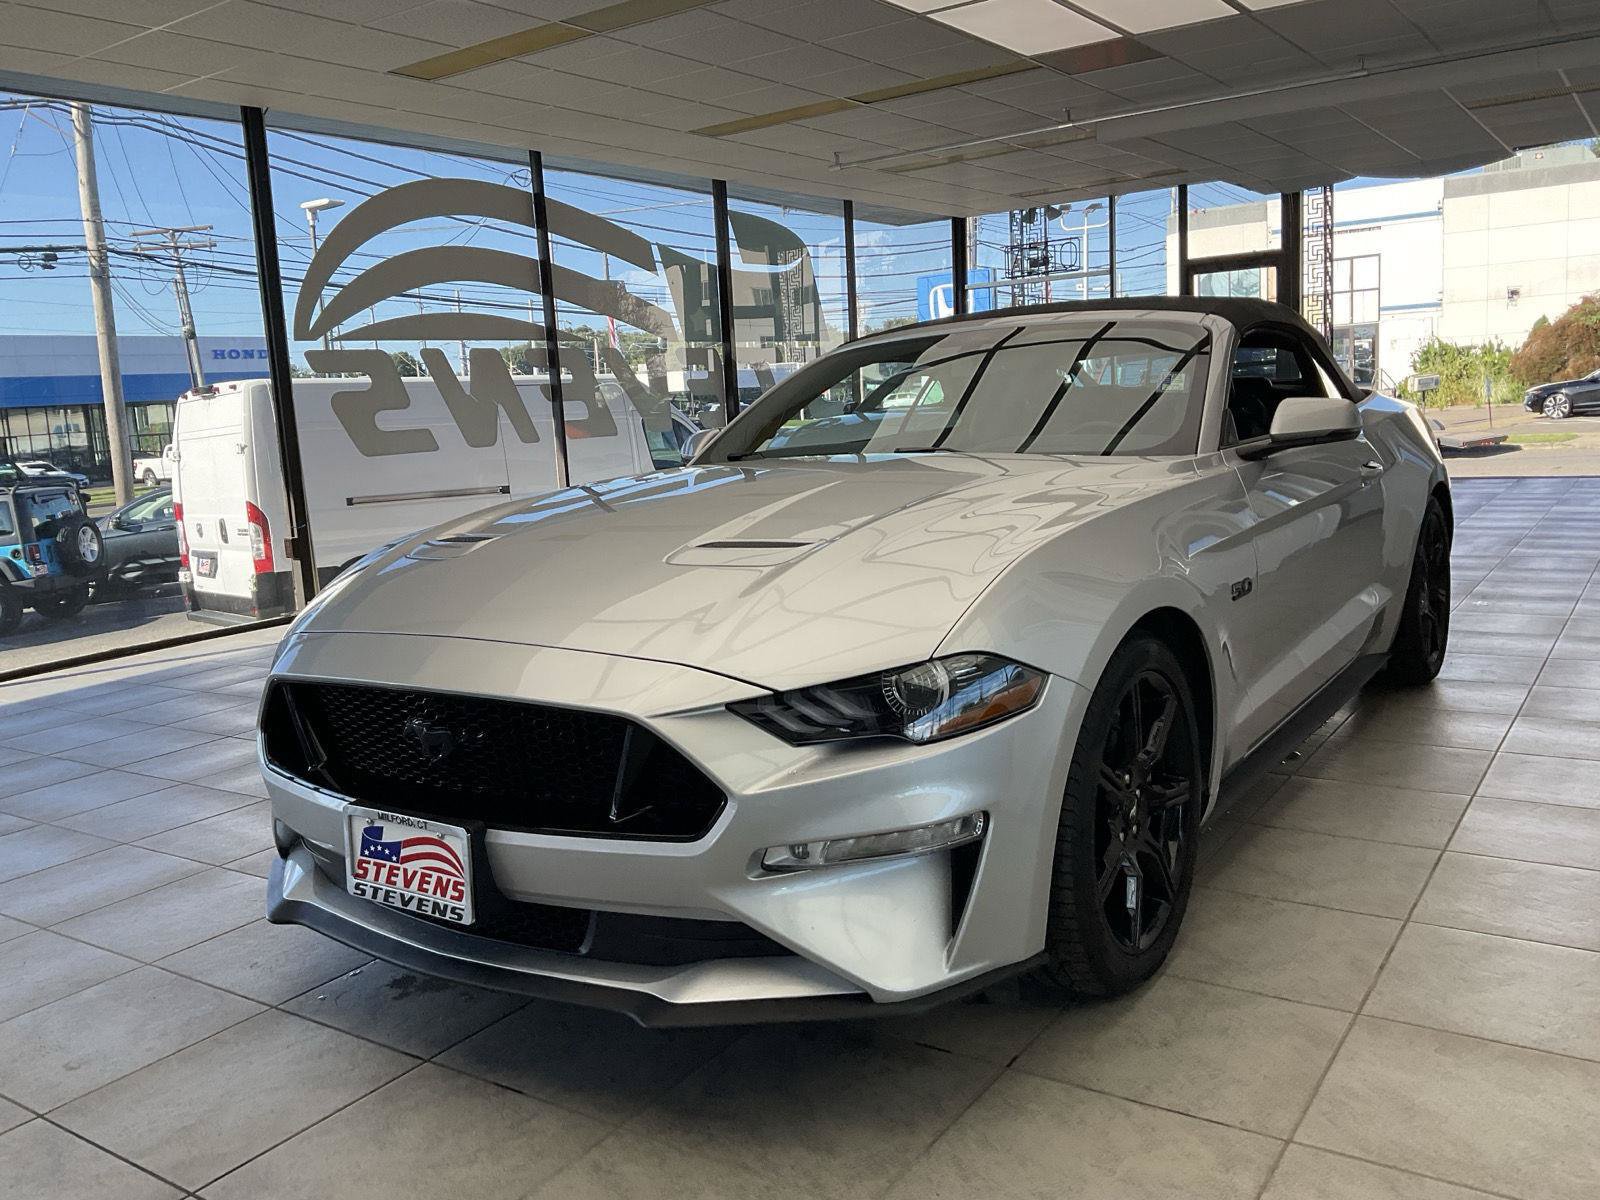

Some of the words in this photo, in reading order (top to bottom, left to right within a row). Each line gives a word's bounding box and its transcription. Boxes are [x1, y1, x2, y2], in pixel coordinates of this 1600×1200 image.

[211, 348, 268, 360] HOND
[377, 811, 416, 829] MILFORD,
[417, 819, 428, 830] CT
[352, 858, 465, 902] STEVENS
[353, 882, 465, 921] STEVENS
